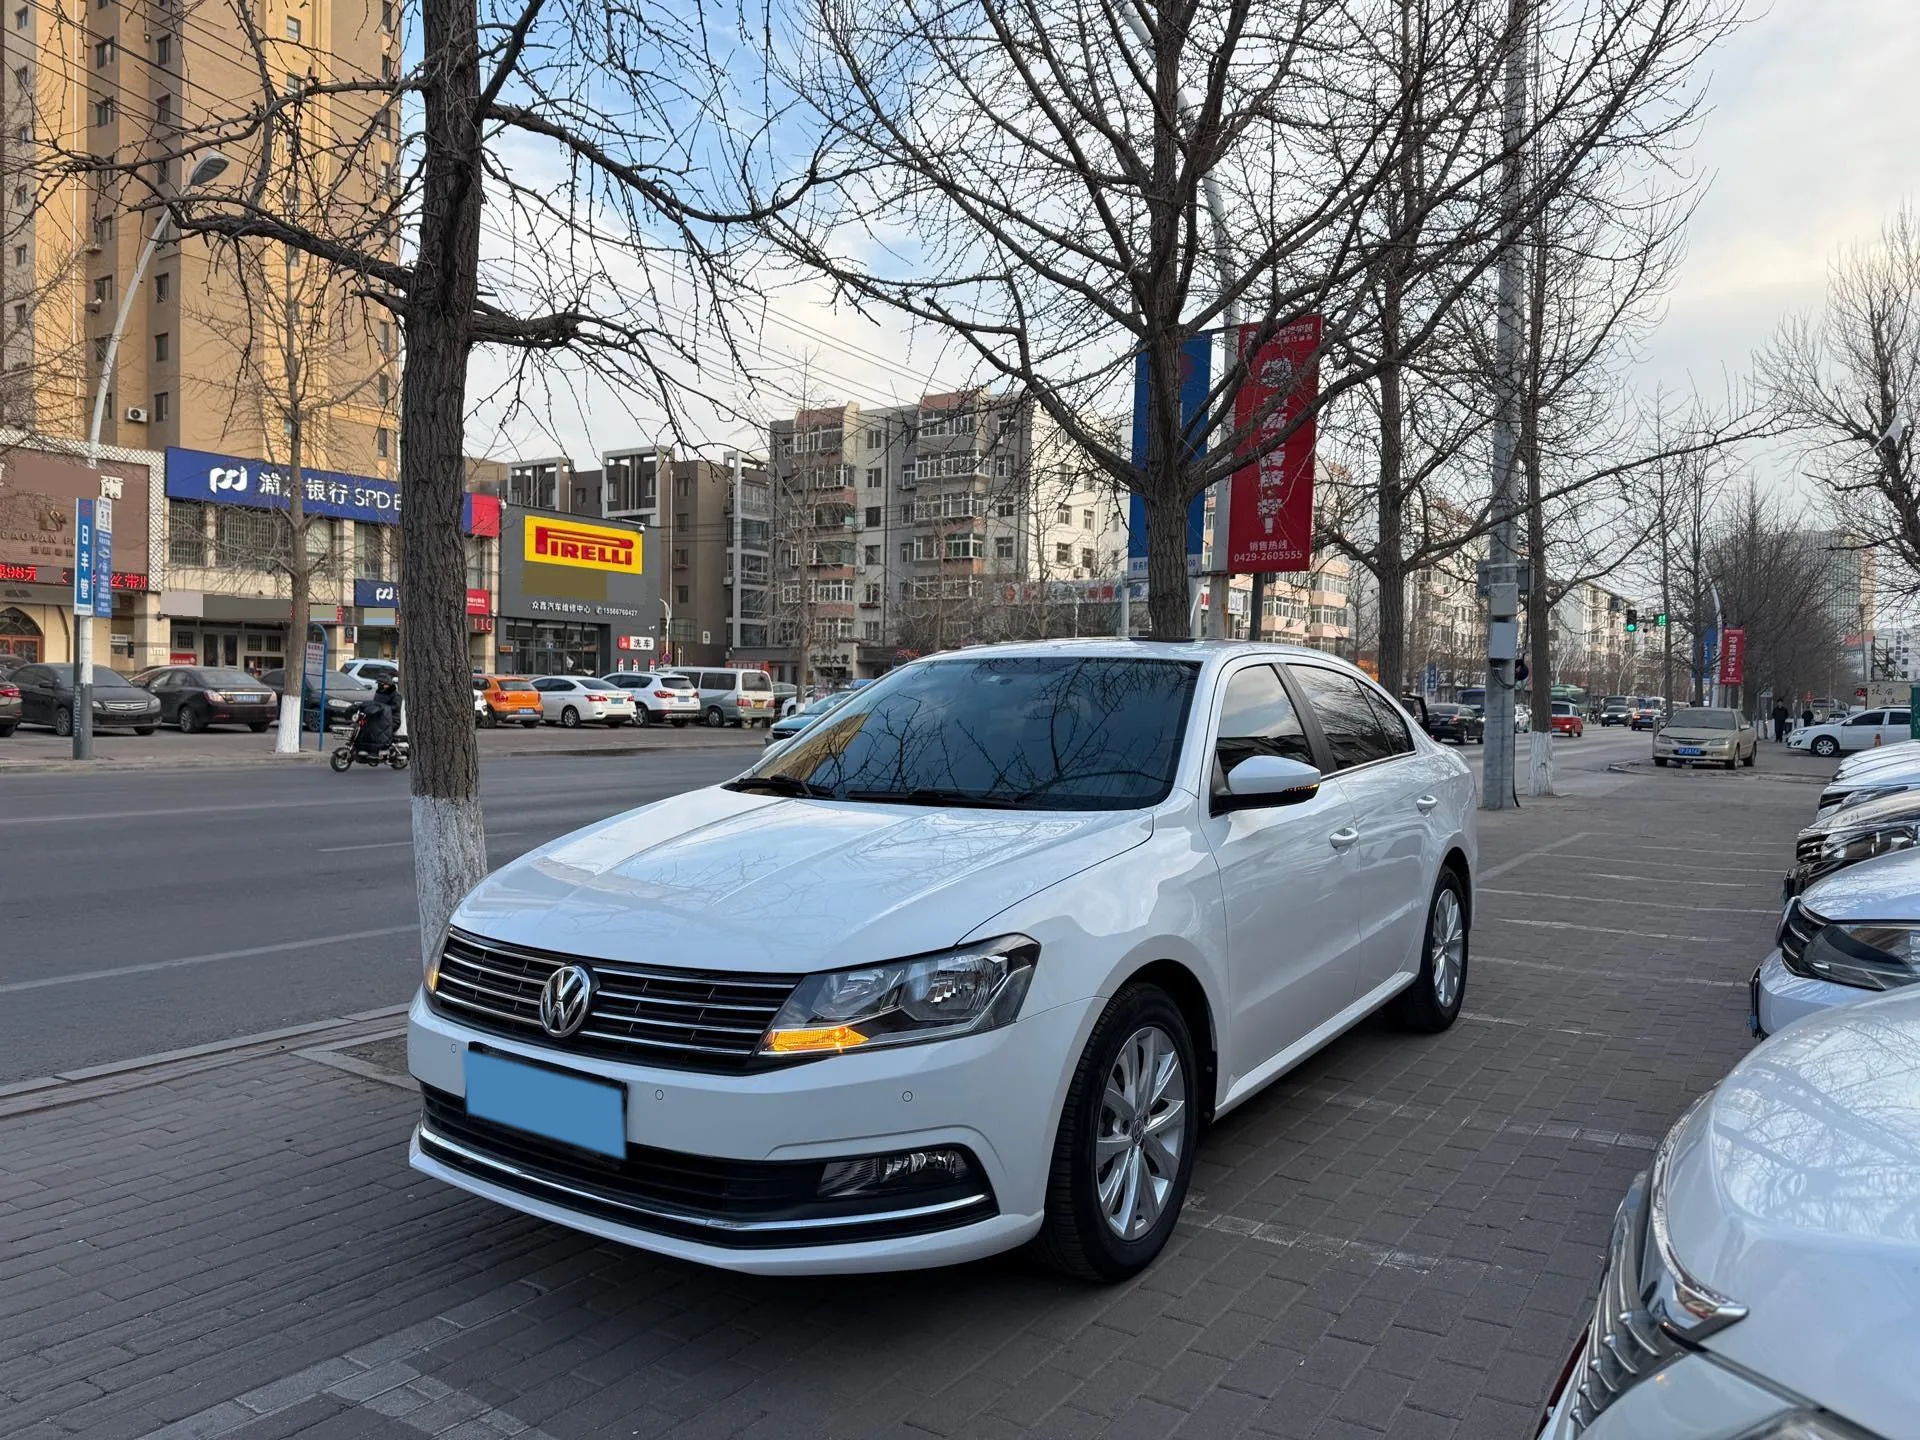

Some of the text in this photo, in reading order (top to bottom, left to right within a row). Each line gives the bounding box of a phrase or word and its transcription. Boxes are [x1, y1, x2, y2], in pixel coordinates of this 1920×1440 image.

[259, 471, 349, 505] 浦银行
[354, 487, 391, 509] SPD
[535, 526, 634, 566] PIRELLI
[1249, 540, 1288, 551] 销售热线
[1233, 551, 1303, 562] 0429-2605555
[532, 600, 591, 614] 众鑫汽车维修中心
[633, 638, 651, 648] 洗车
